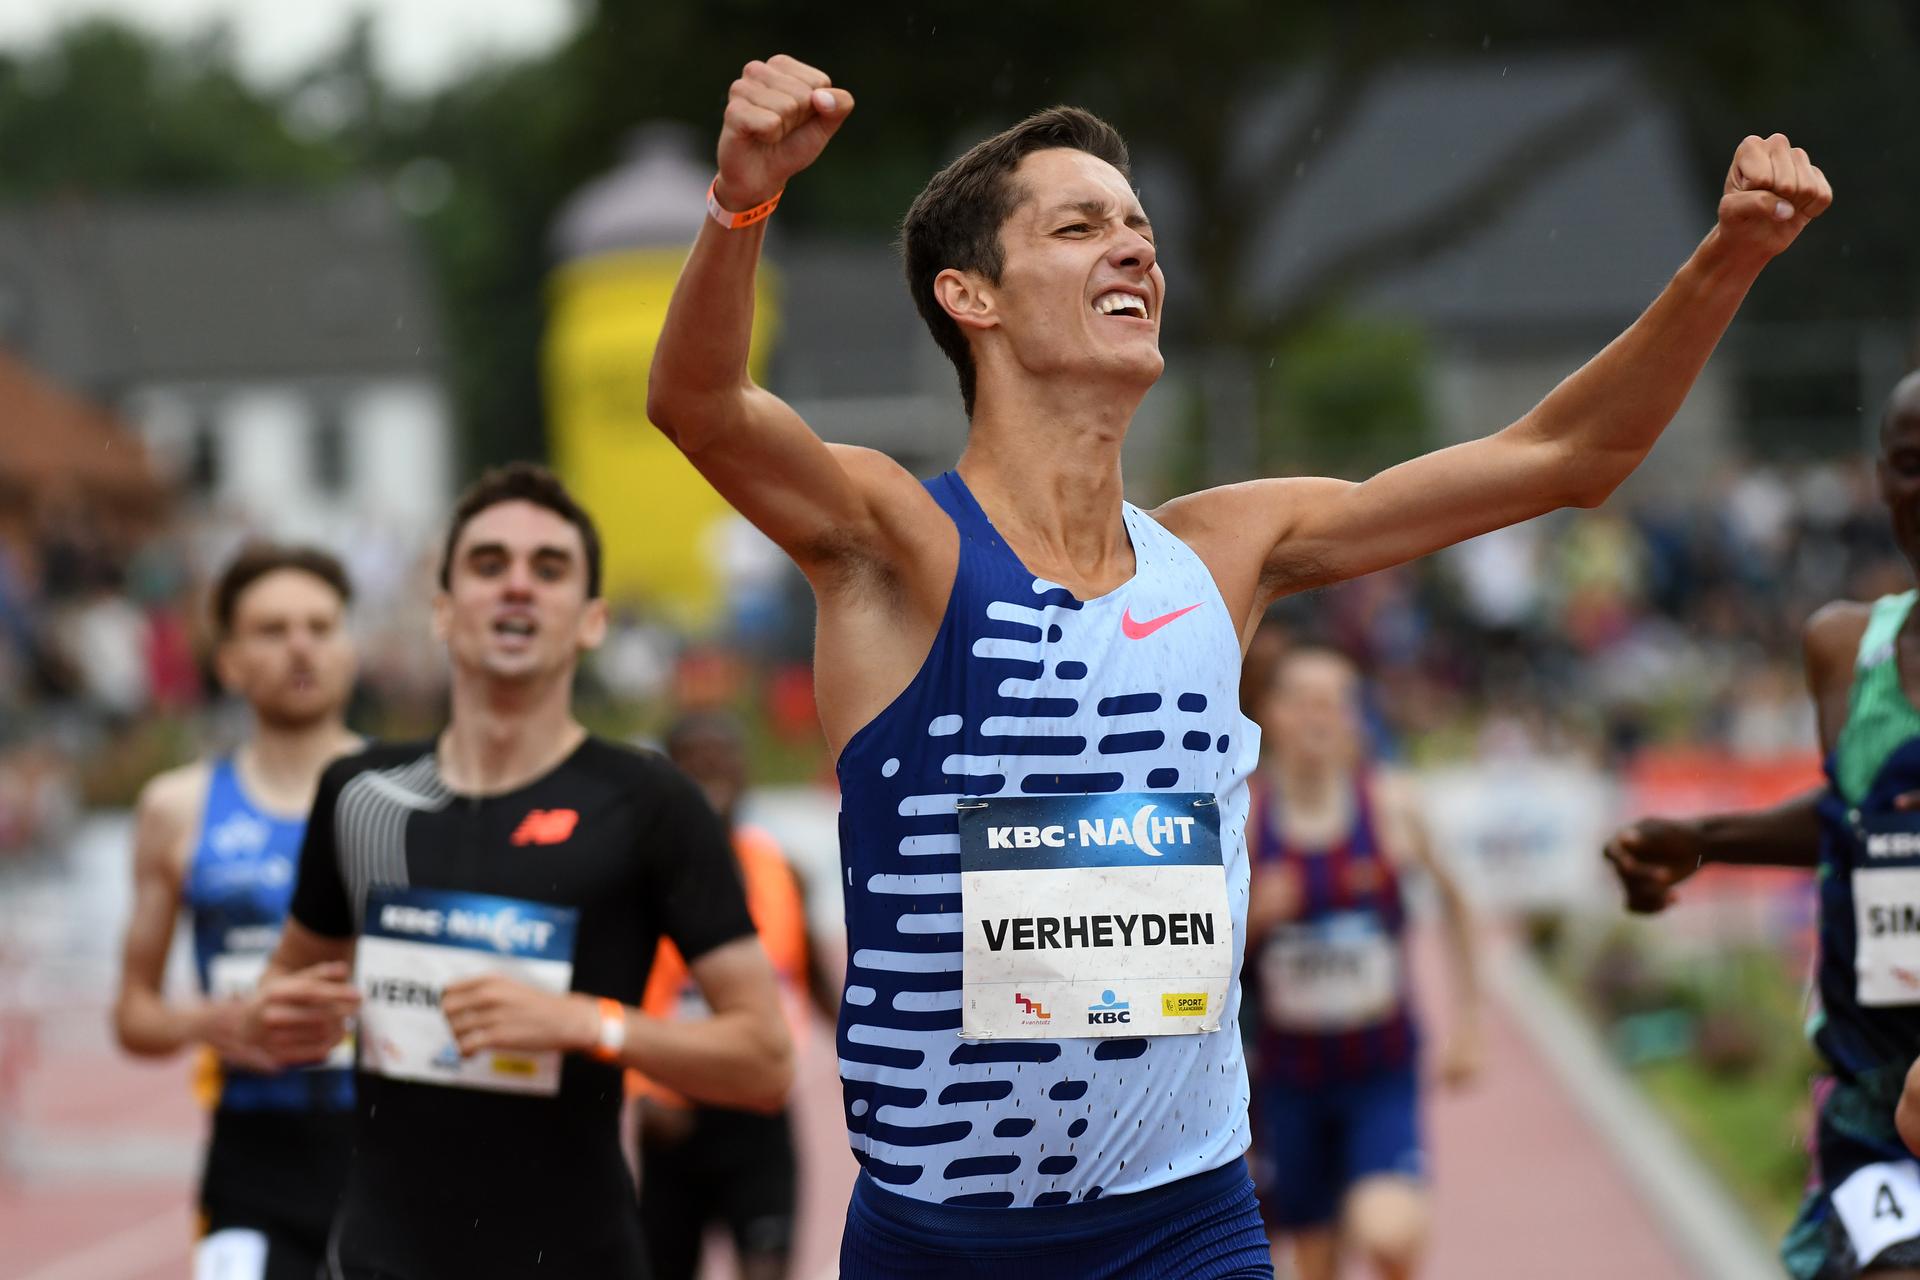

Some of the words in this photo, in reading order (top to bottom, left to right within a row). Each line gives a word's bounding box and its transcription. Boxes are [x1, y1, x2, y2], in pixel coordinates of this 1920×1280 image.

[981, 912, 1215, 952] VERHEYDEN
[1088, 1011, 1131, 1025] KBC
[1875, 1182, 1904, 1220] 4
